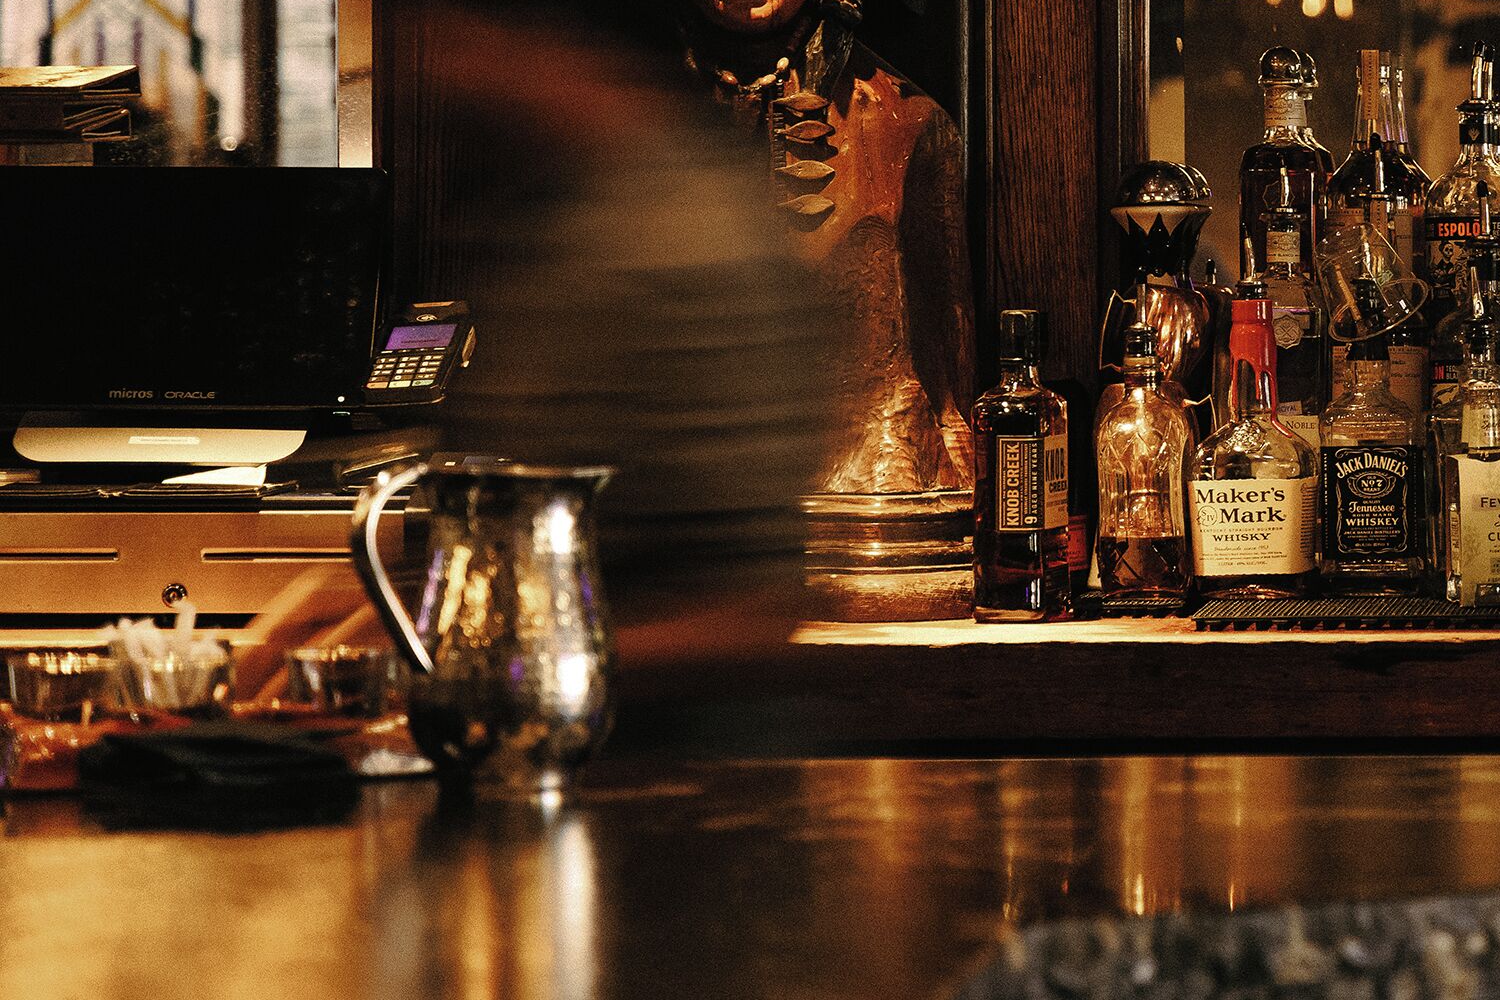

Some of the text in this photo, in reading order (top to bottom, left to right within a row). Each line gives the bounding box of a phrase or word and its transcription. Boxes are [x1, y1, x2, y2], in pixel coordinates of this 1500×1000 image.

[109, 387, 216, 399] micros ORACLE
[1286, 421, 1316, 430] NOBLE
[1046, 448, 1065, 481] KNOB
[1335, 452, 1409, 479] JACK DANIEL'S
[1007, 442, 1020, 526] KNOB CREEK
[1196, 488, 1285, 504] Maker's
[1348, 501, 1396, 513] Tennessee
[1024, 516, 1038, 525] 9
[1220, 507, 1286, 523] Mark
[1345, 517, 1399, 526] WHISKEY
[1213, 533, 1271, 541] WHISKY
